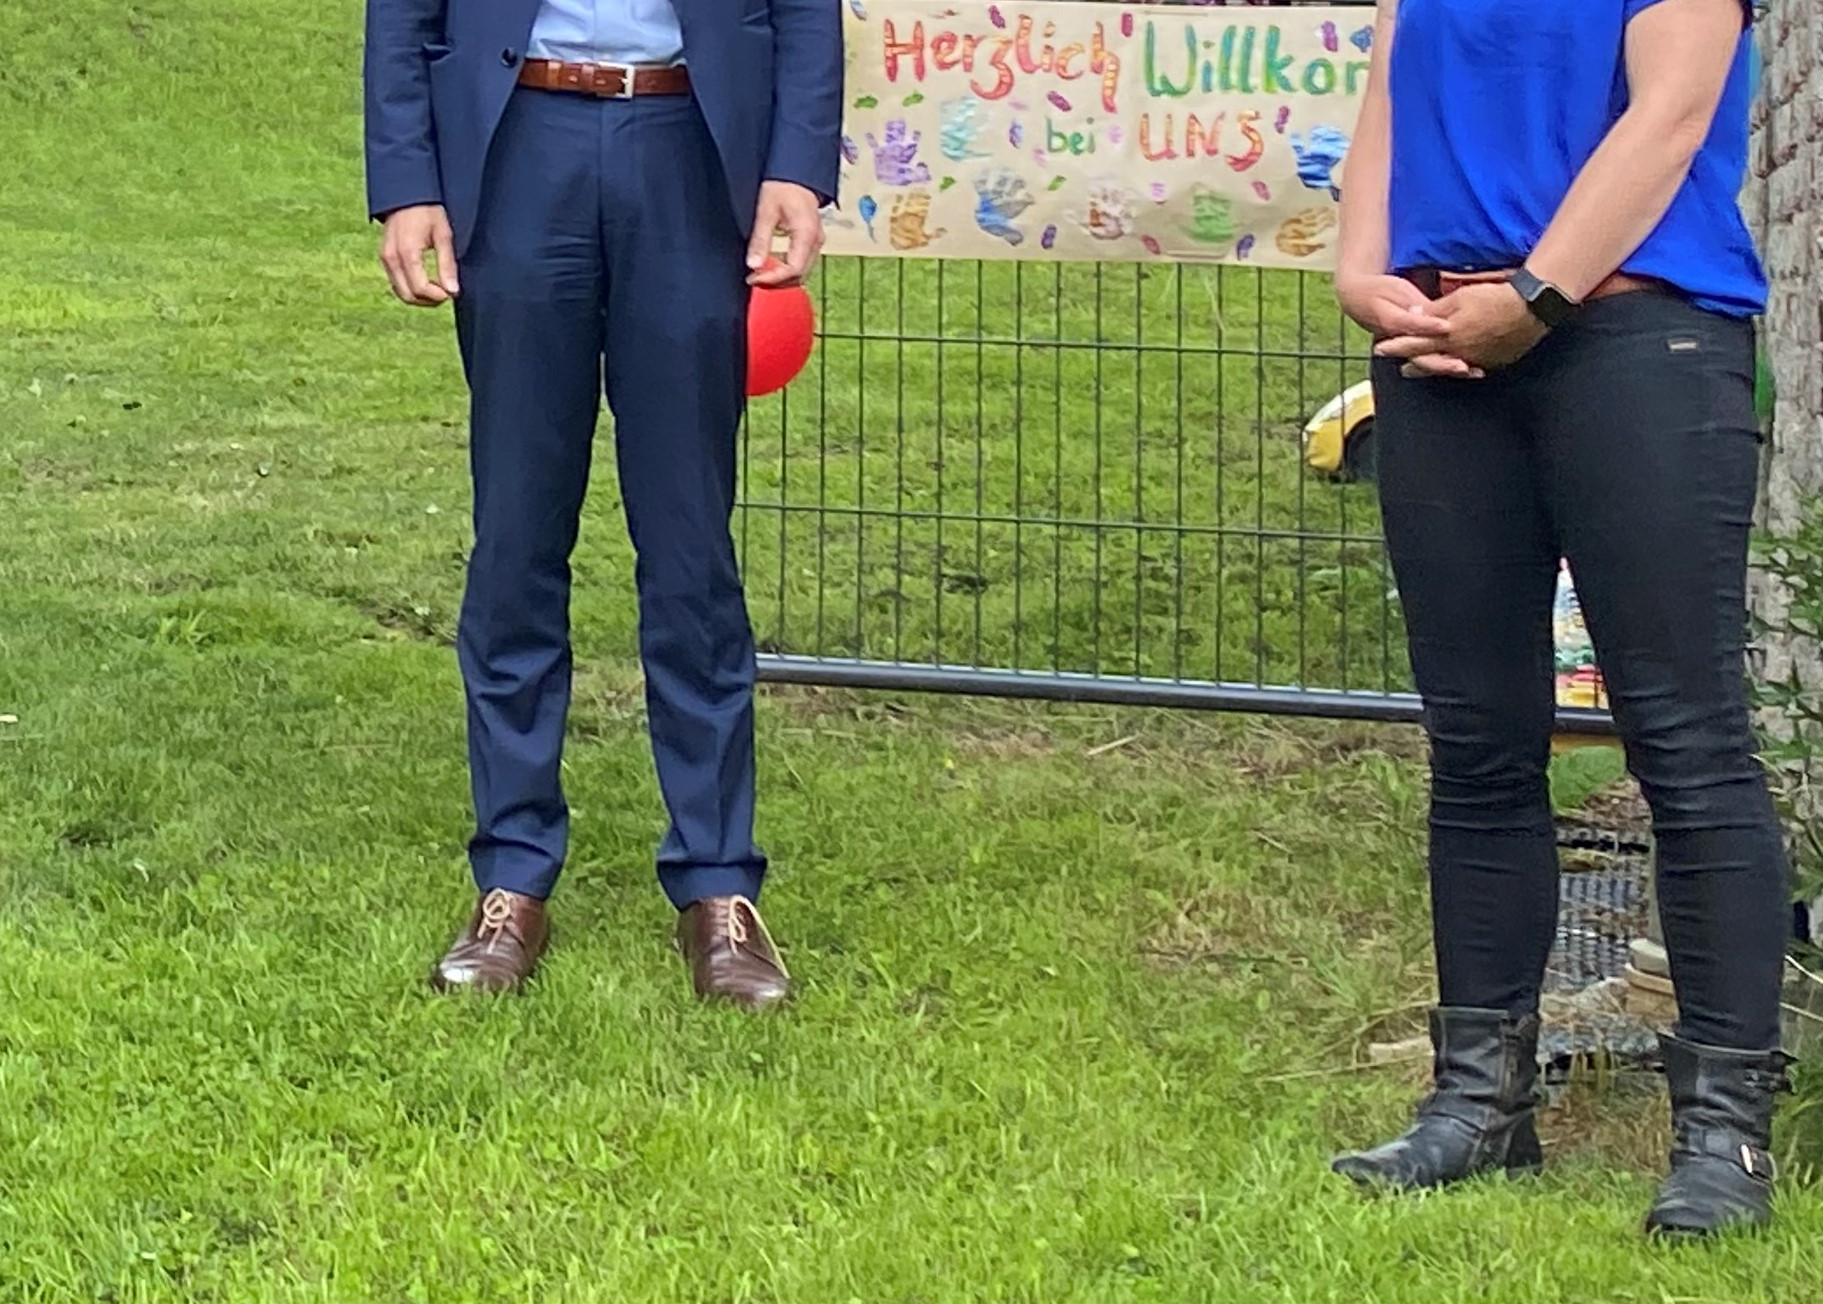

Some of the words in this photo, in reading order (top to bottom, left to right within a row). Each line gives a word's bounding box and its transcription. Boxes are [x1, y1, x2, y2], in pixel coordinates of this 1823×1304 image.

[884, 13, 1120, 113] Herzlich
[1046, 116, 1095, 155] bei
[1139, 110, 1264, 172] UNS
